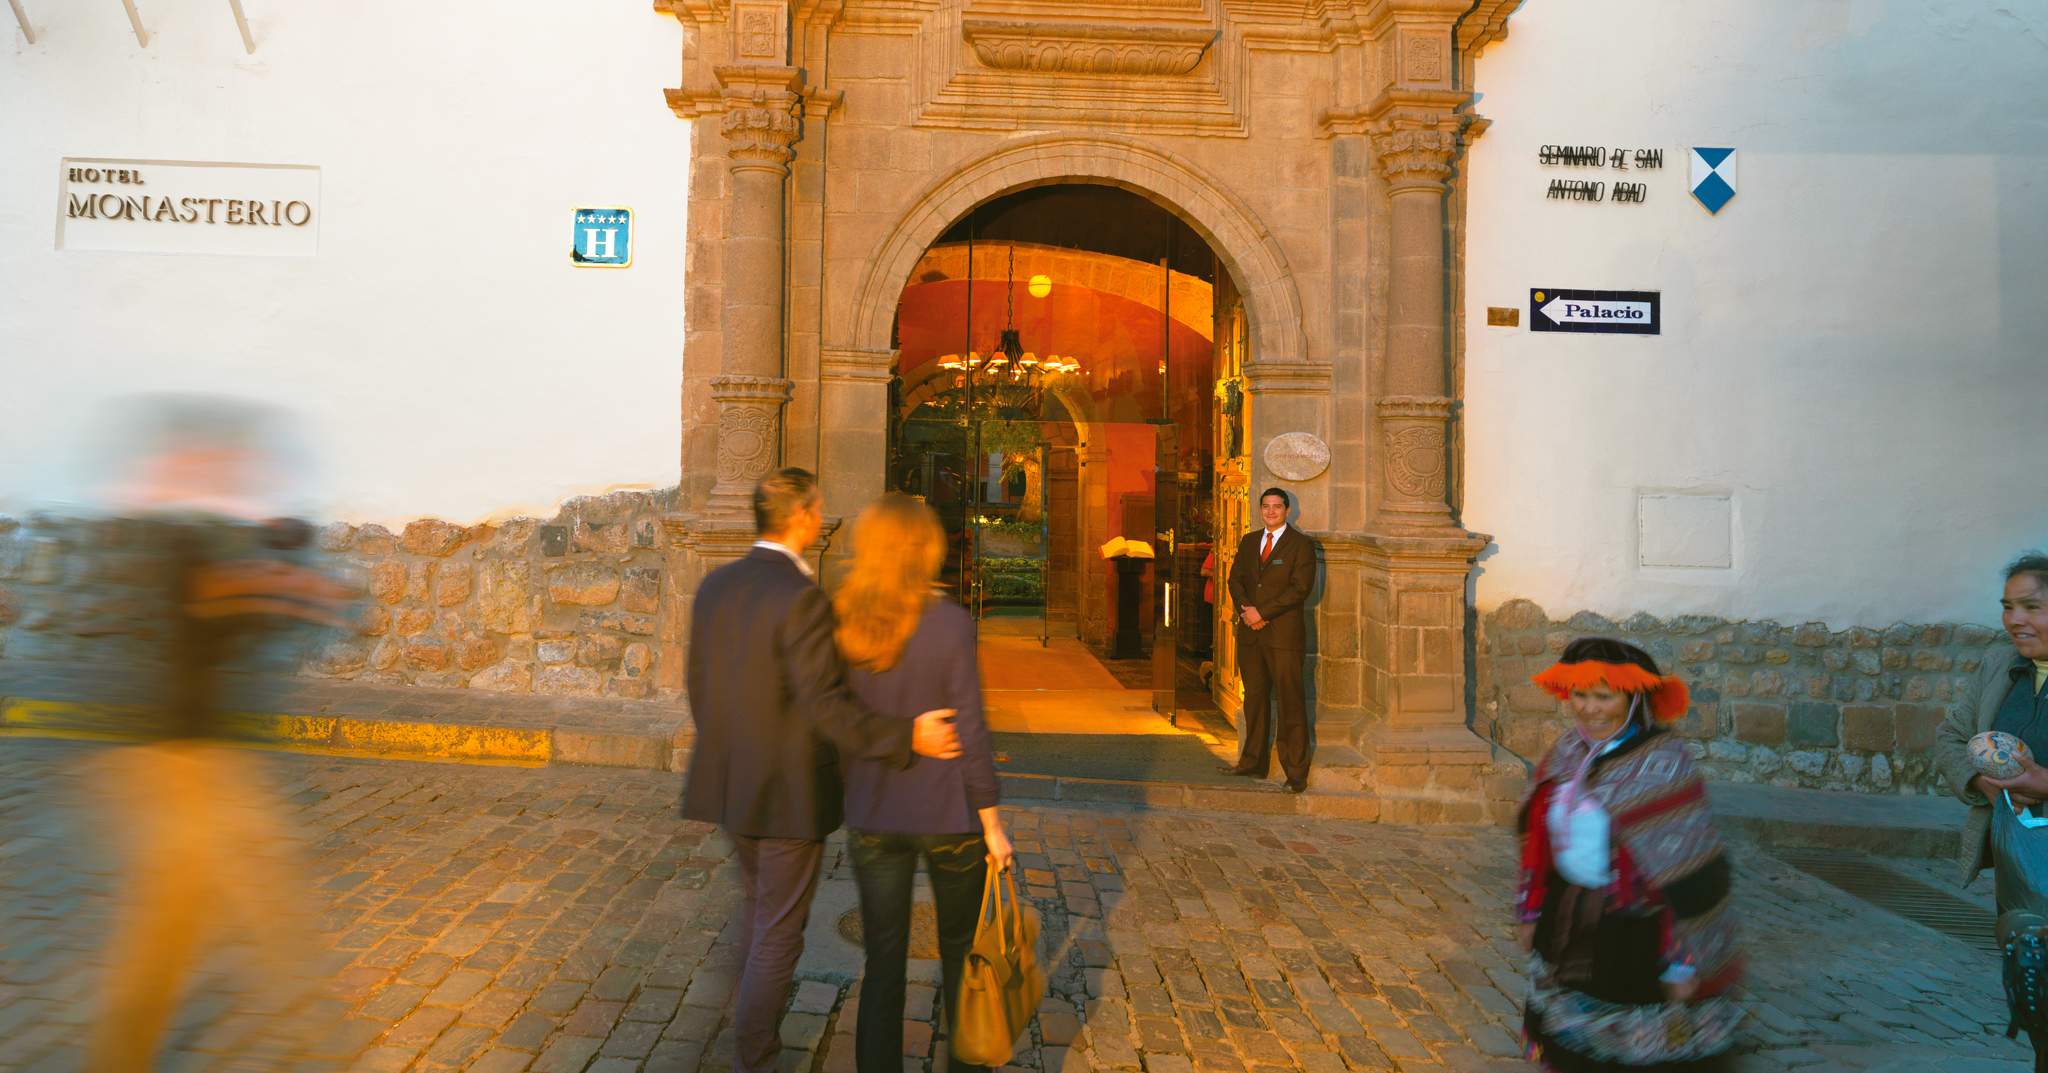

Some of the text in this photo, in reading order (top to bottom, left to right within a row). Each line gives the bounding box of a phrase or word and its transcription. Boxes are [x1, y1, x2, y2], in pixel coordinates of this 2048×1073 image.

[1609, 148, 1632, 170] DE
[1635, 148, 1663, 169] SAN
[68, 167, 145, 185] HOTEL
[1546, 179, 1647, 203] ANTONIO ABAD
[66, 192, 312, 227] MONASTERIO
[583, 228, 619, 258] H
[1565, 304, 1644, 319] Palacio
